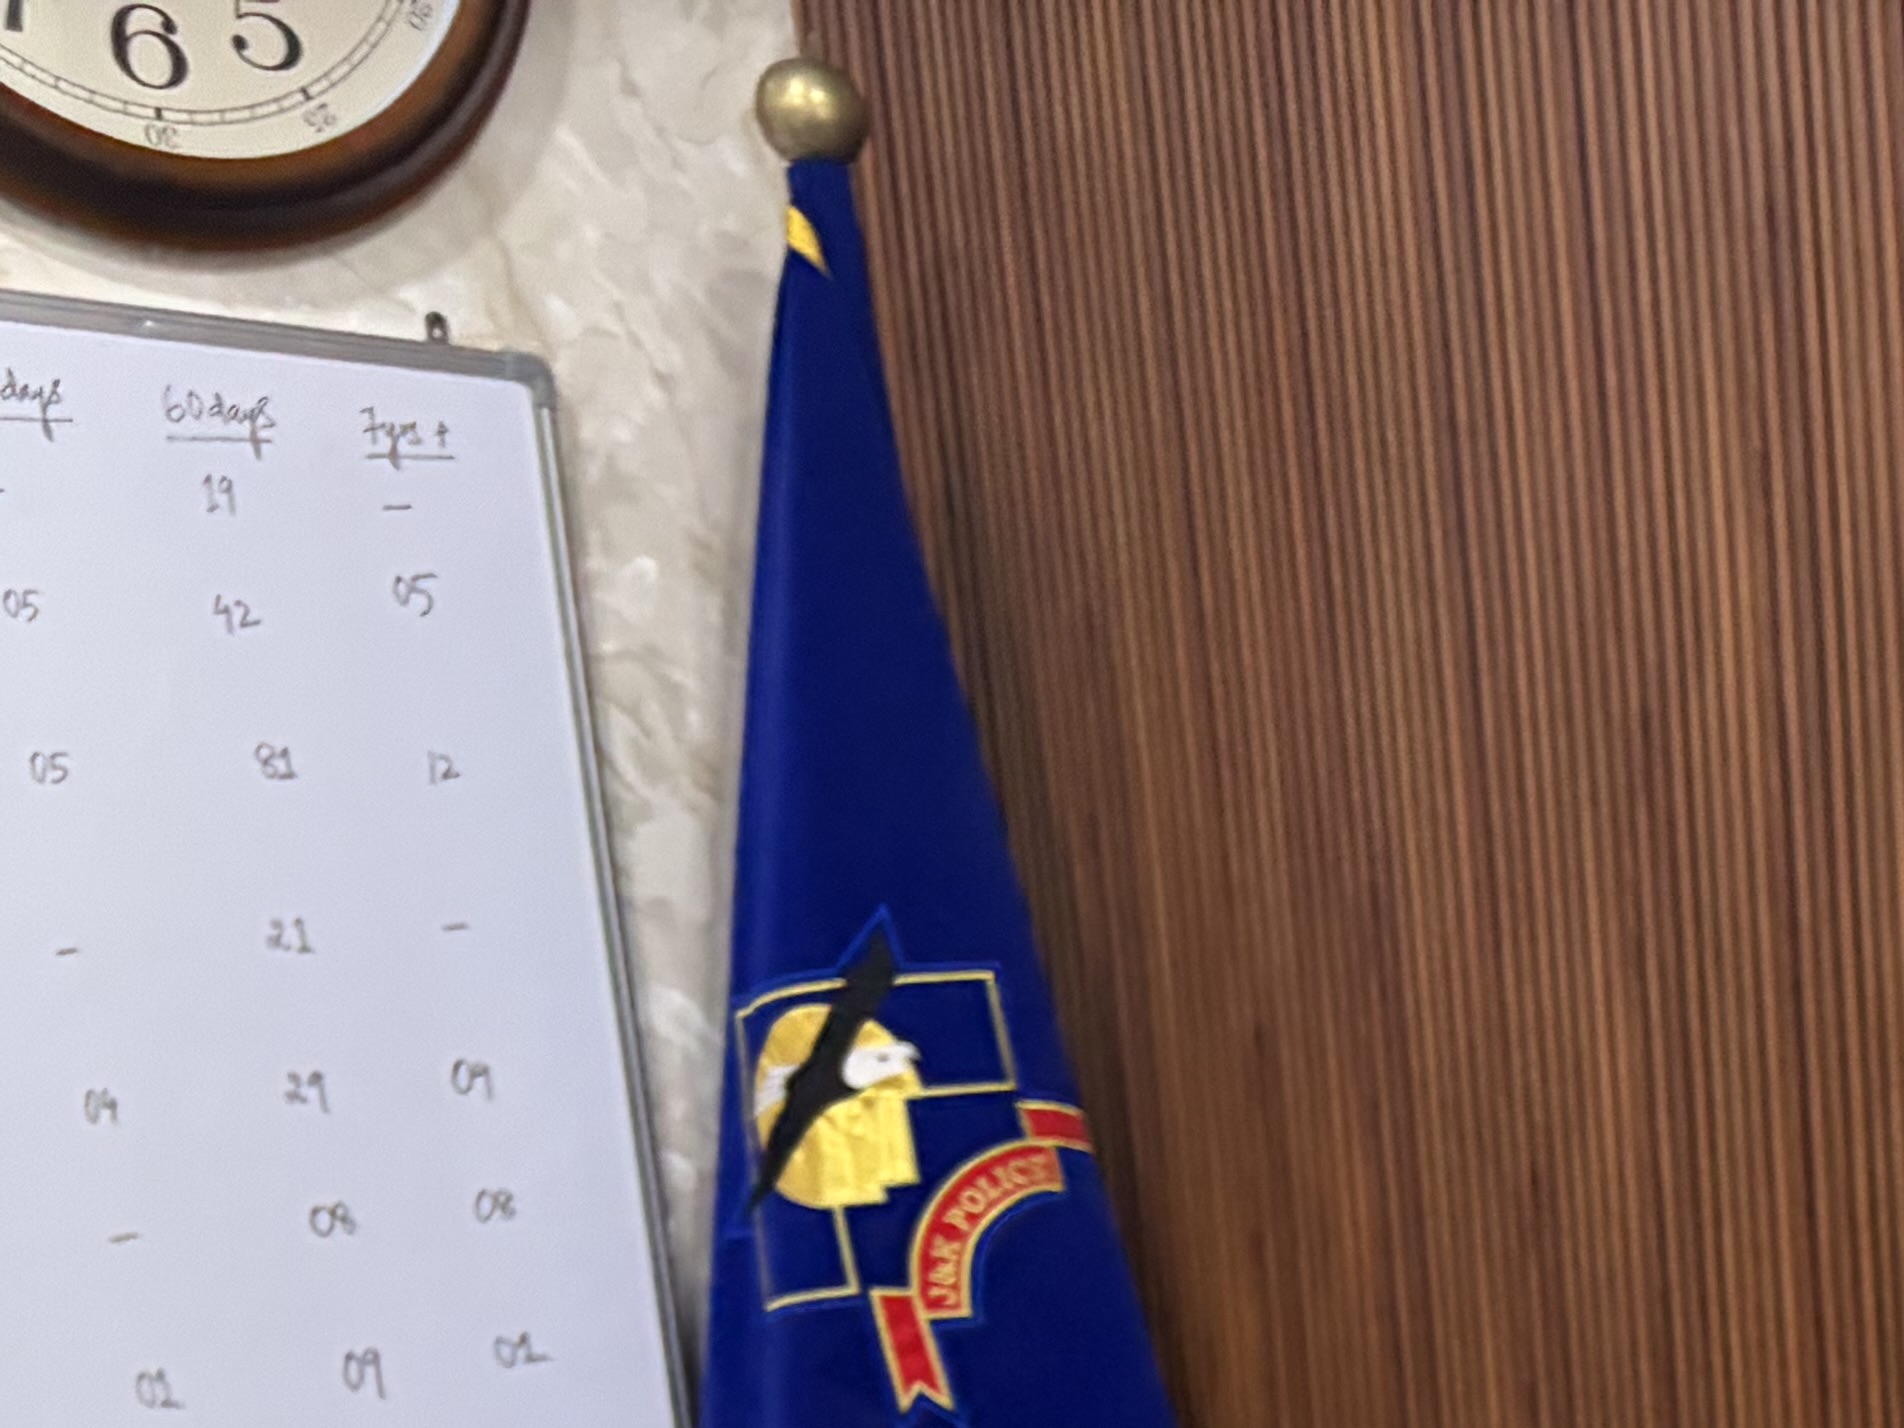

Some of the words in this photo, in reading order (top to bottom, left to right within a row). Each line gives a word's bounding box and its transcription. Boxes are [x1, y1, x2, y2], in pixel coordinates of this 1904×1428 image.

[109, 3, 191, 91] 6
[231, 0, 304, 72] 5
[213, 596, 261, 633] 42
[393, 573, 438, 617] 05
[29, 752, 70, 785] 05
[427, 752, 461, 783] 12
[342, 1346, 385, 1400] 09
